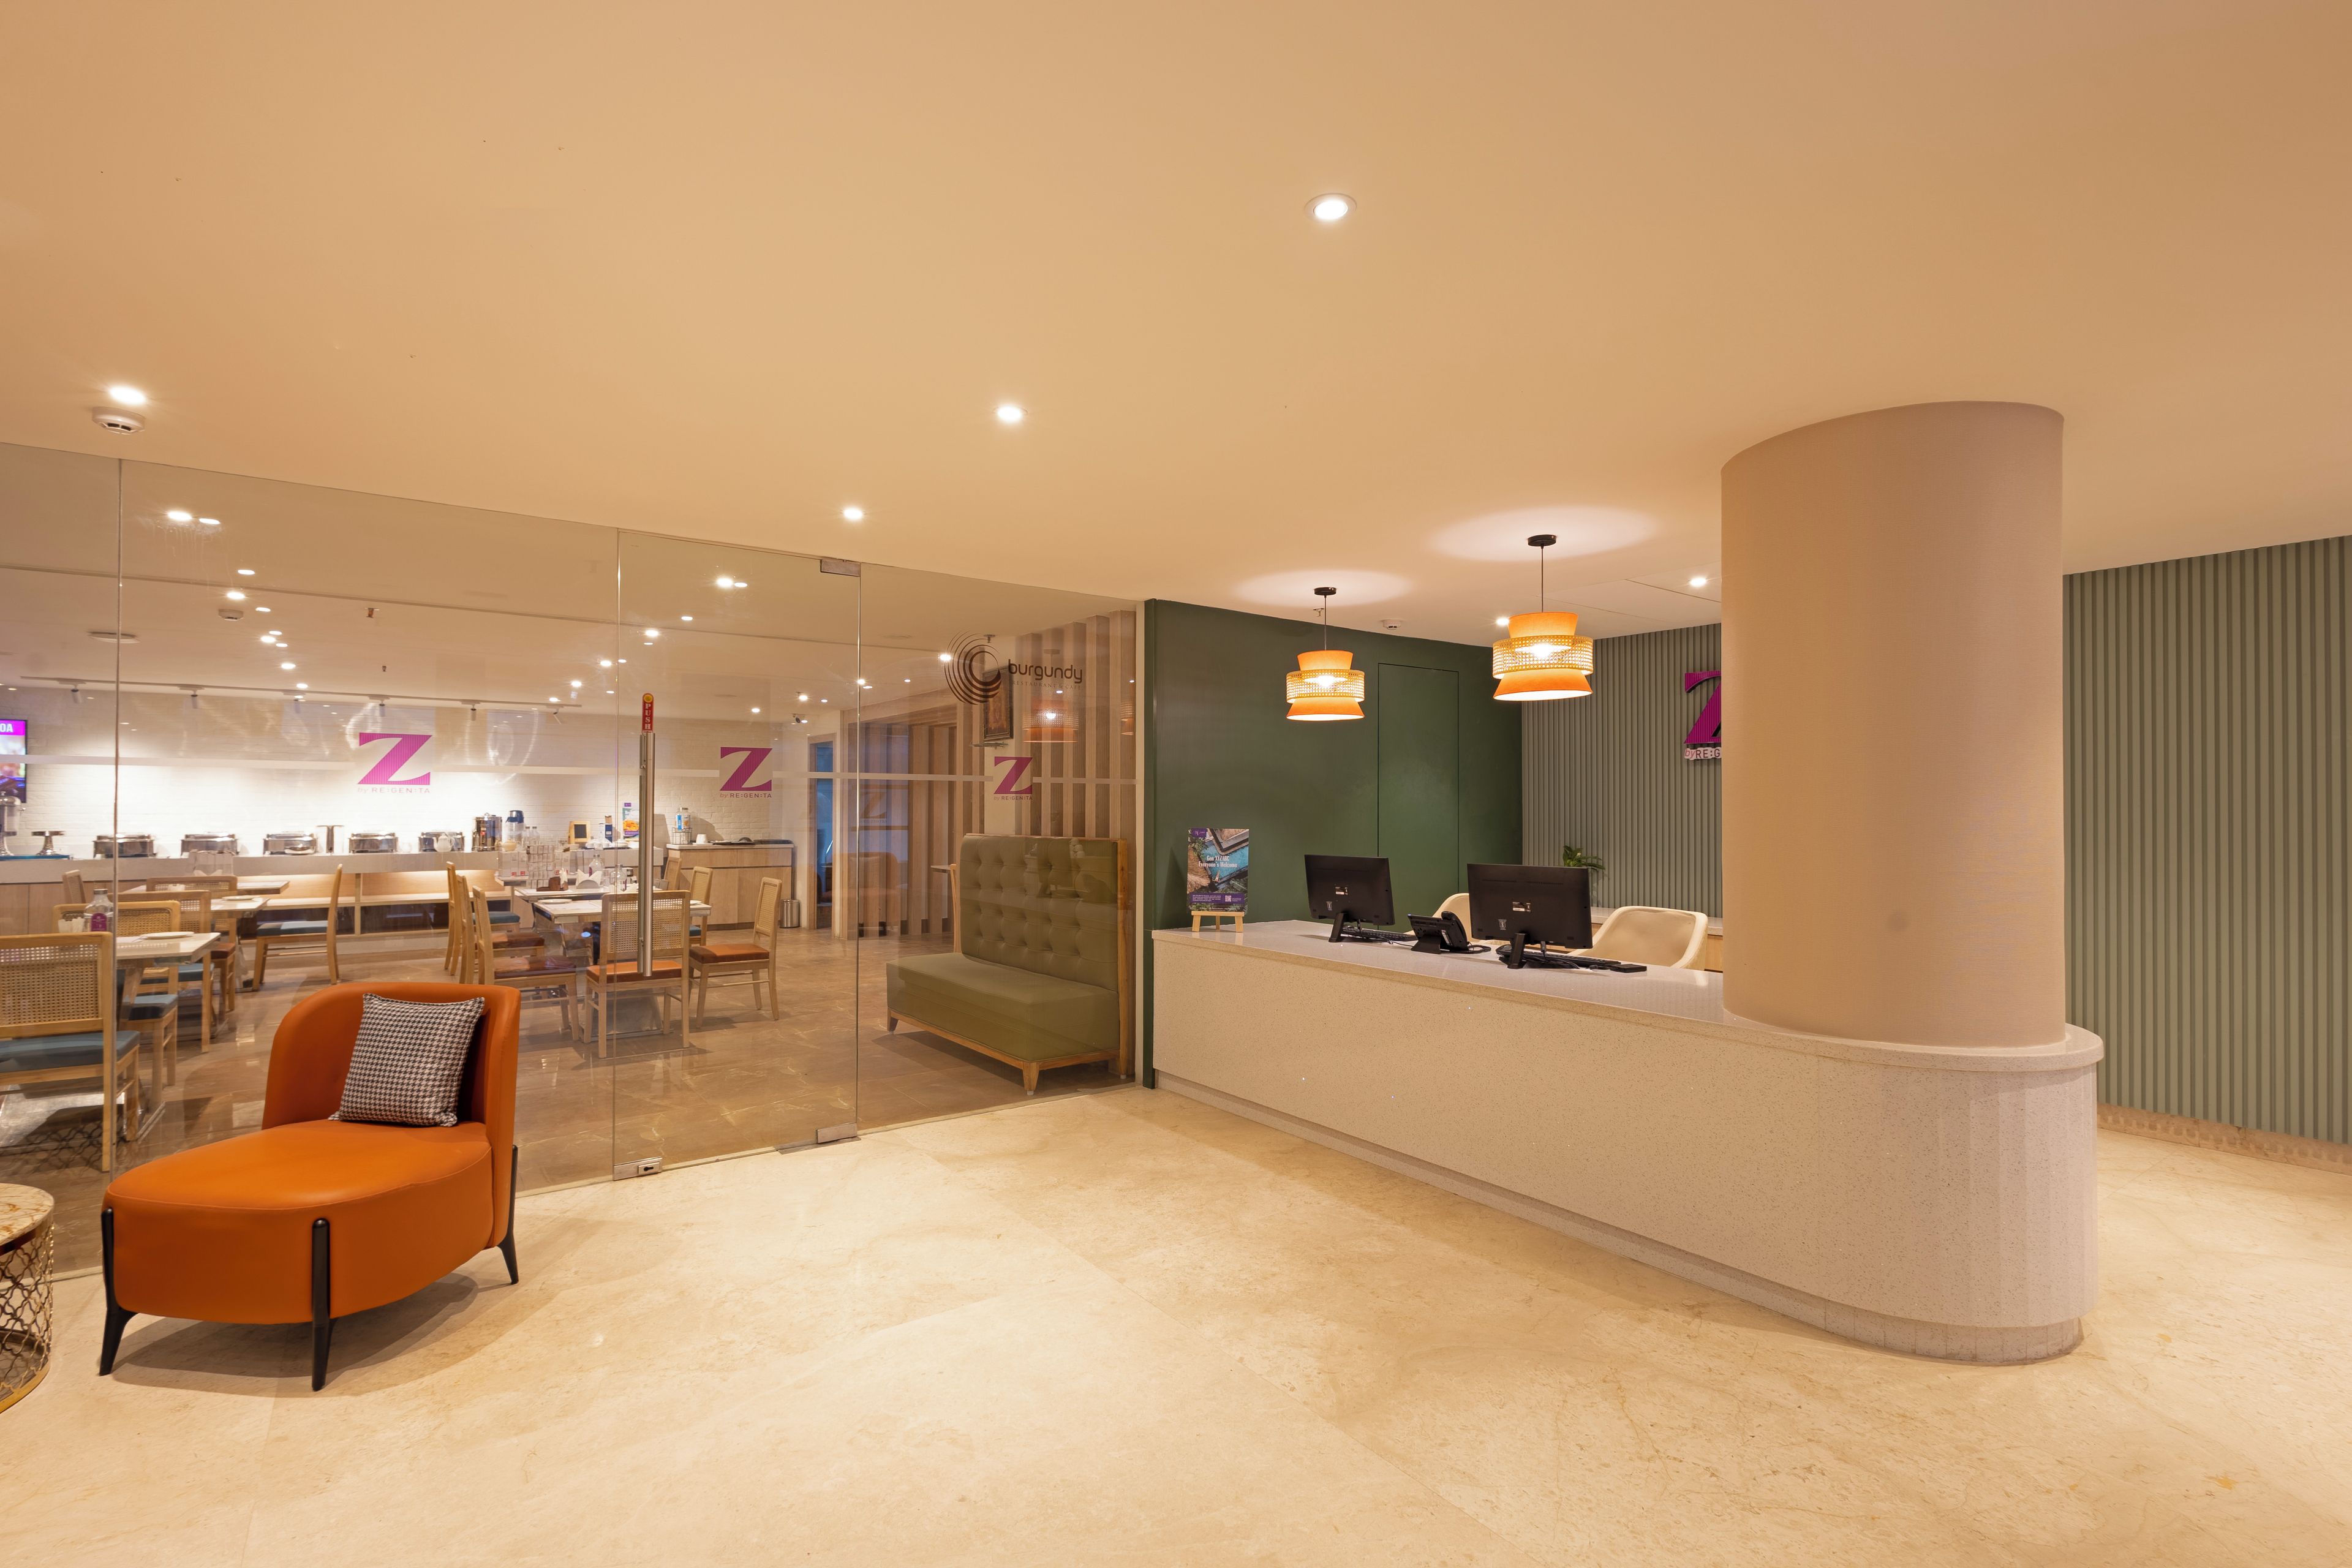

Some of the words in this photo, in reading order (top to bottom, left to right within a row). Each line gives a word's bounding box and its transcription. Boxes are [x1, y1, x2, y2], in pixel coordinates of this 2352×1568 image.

[1008, 659, 1082, 684] burgundy
[358, 733, 432, 785] Z
[720, 747, 772, 791] Z
[1686, 748, 1696, 759] by
[993, 756, 1033, 794] Z
